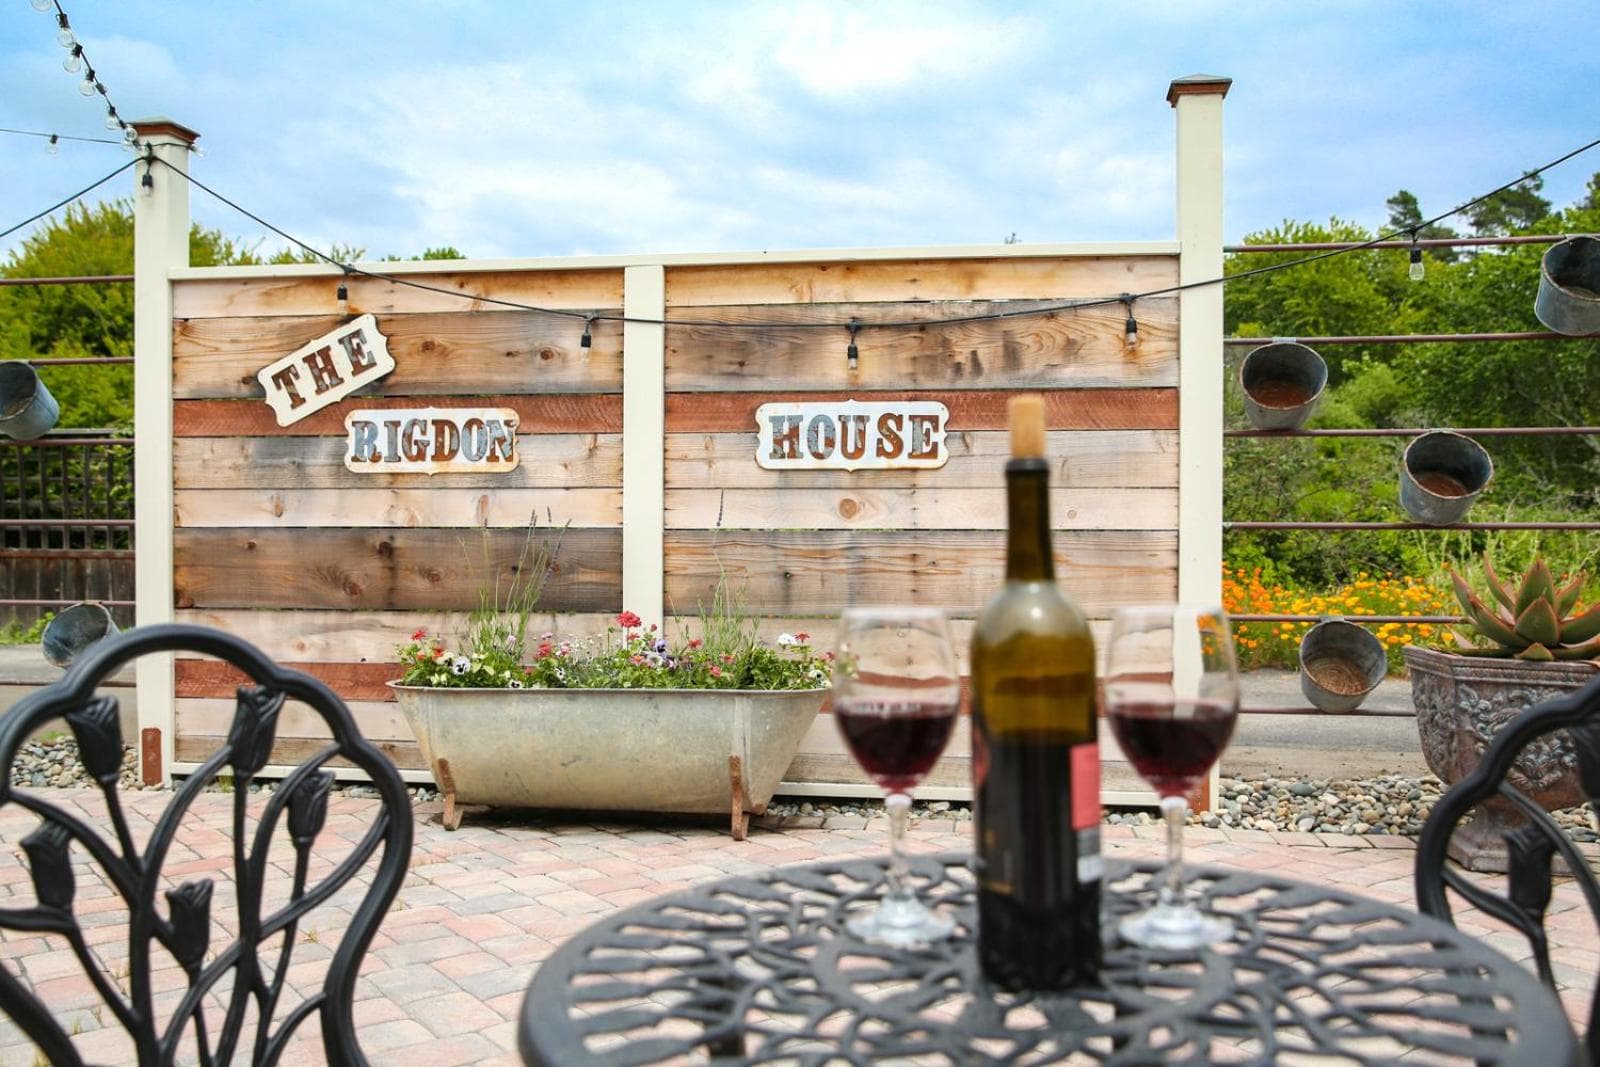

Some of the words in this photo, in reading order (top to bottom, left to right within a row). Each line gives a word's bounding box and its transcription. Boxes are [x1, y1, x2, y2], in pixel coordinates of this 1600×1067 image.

[271, 328, 377, 410] THE
[351, 418, 515, 463] RIGDON
[768, 412, 940, 460] HOUSE
